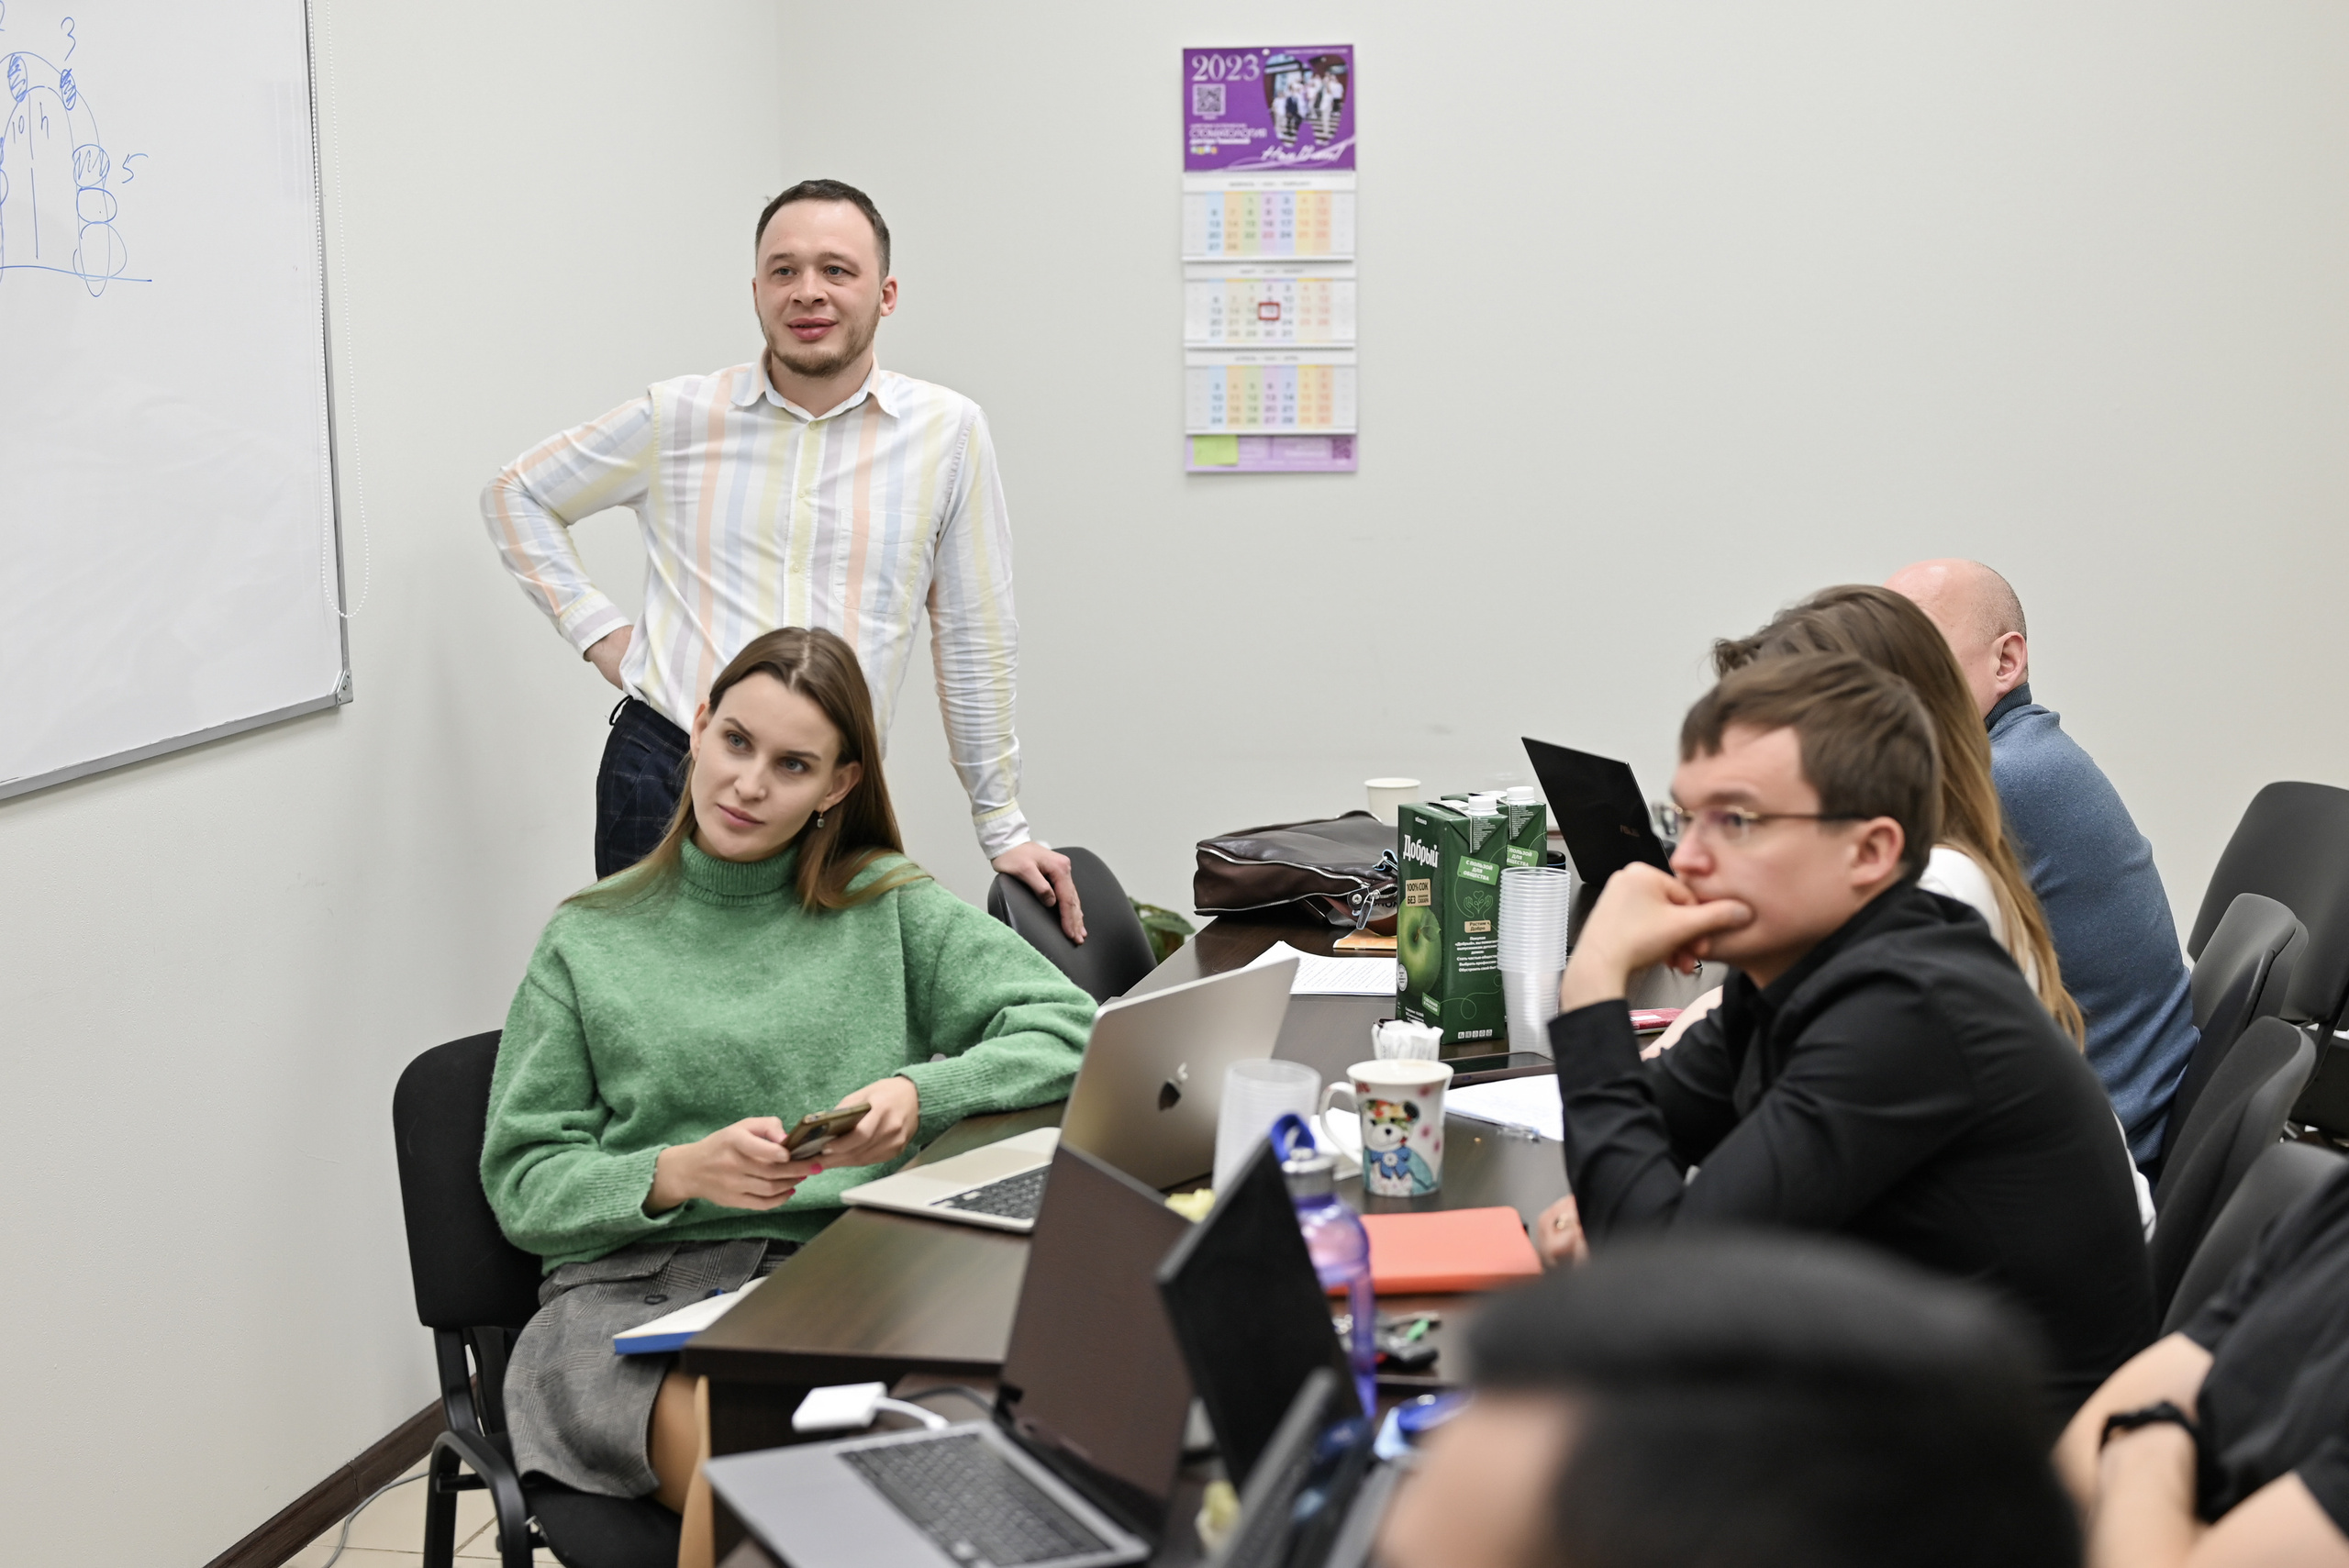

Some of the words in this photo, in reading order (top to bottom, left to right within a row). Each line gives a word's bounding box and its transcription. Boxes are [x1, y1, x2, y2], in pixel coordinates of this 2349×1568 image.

[61, 17, 76, 61] 3
[1191, 53, 1261, 82] 2023
[122, 153, 149, 184] 5
[1403, 834, 1439, 868] Добрый
[1509, 847, 1533, 857] ПОЛЬЗОЙ
[1471, 860, 1494, 871] ПОЛЬЗОЙ
[1507, 858, 1530, 867] БЩЕСТВА
[1463, 870, 1489, 881] ОБЩЕСТВА
[1407, 883, 1419, 892] 100%
[1419, 882, 1429, 891] СОК
[1408, 895, 1416, 904] БЕЗ
